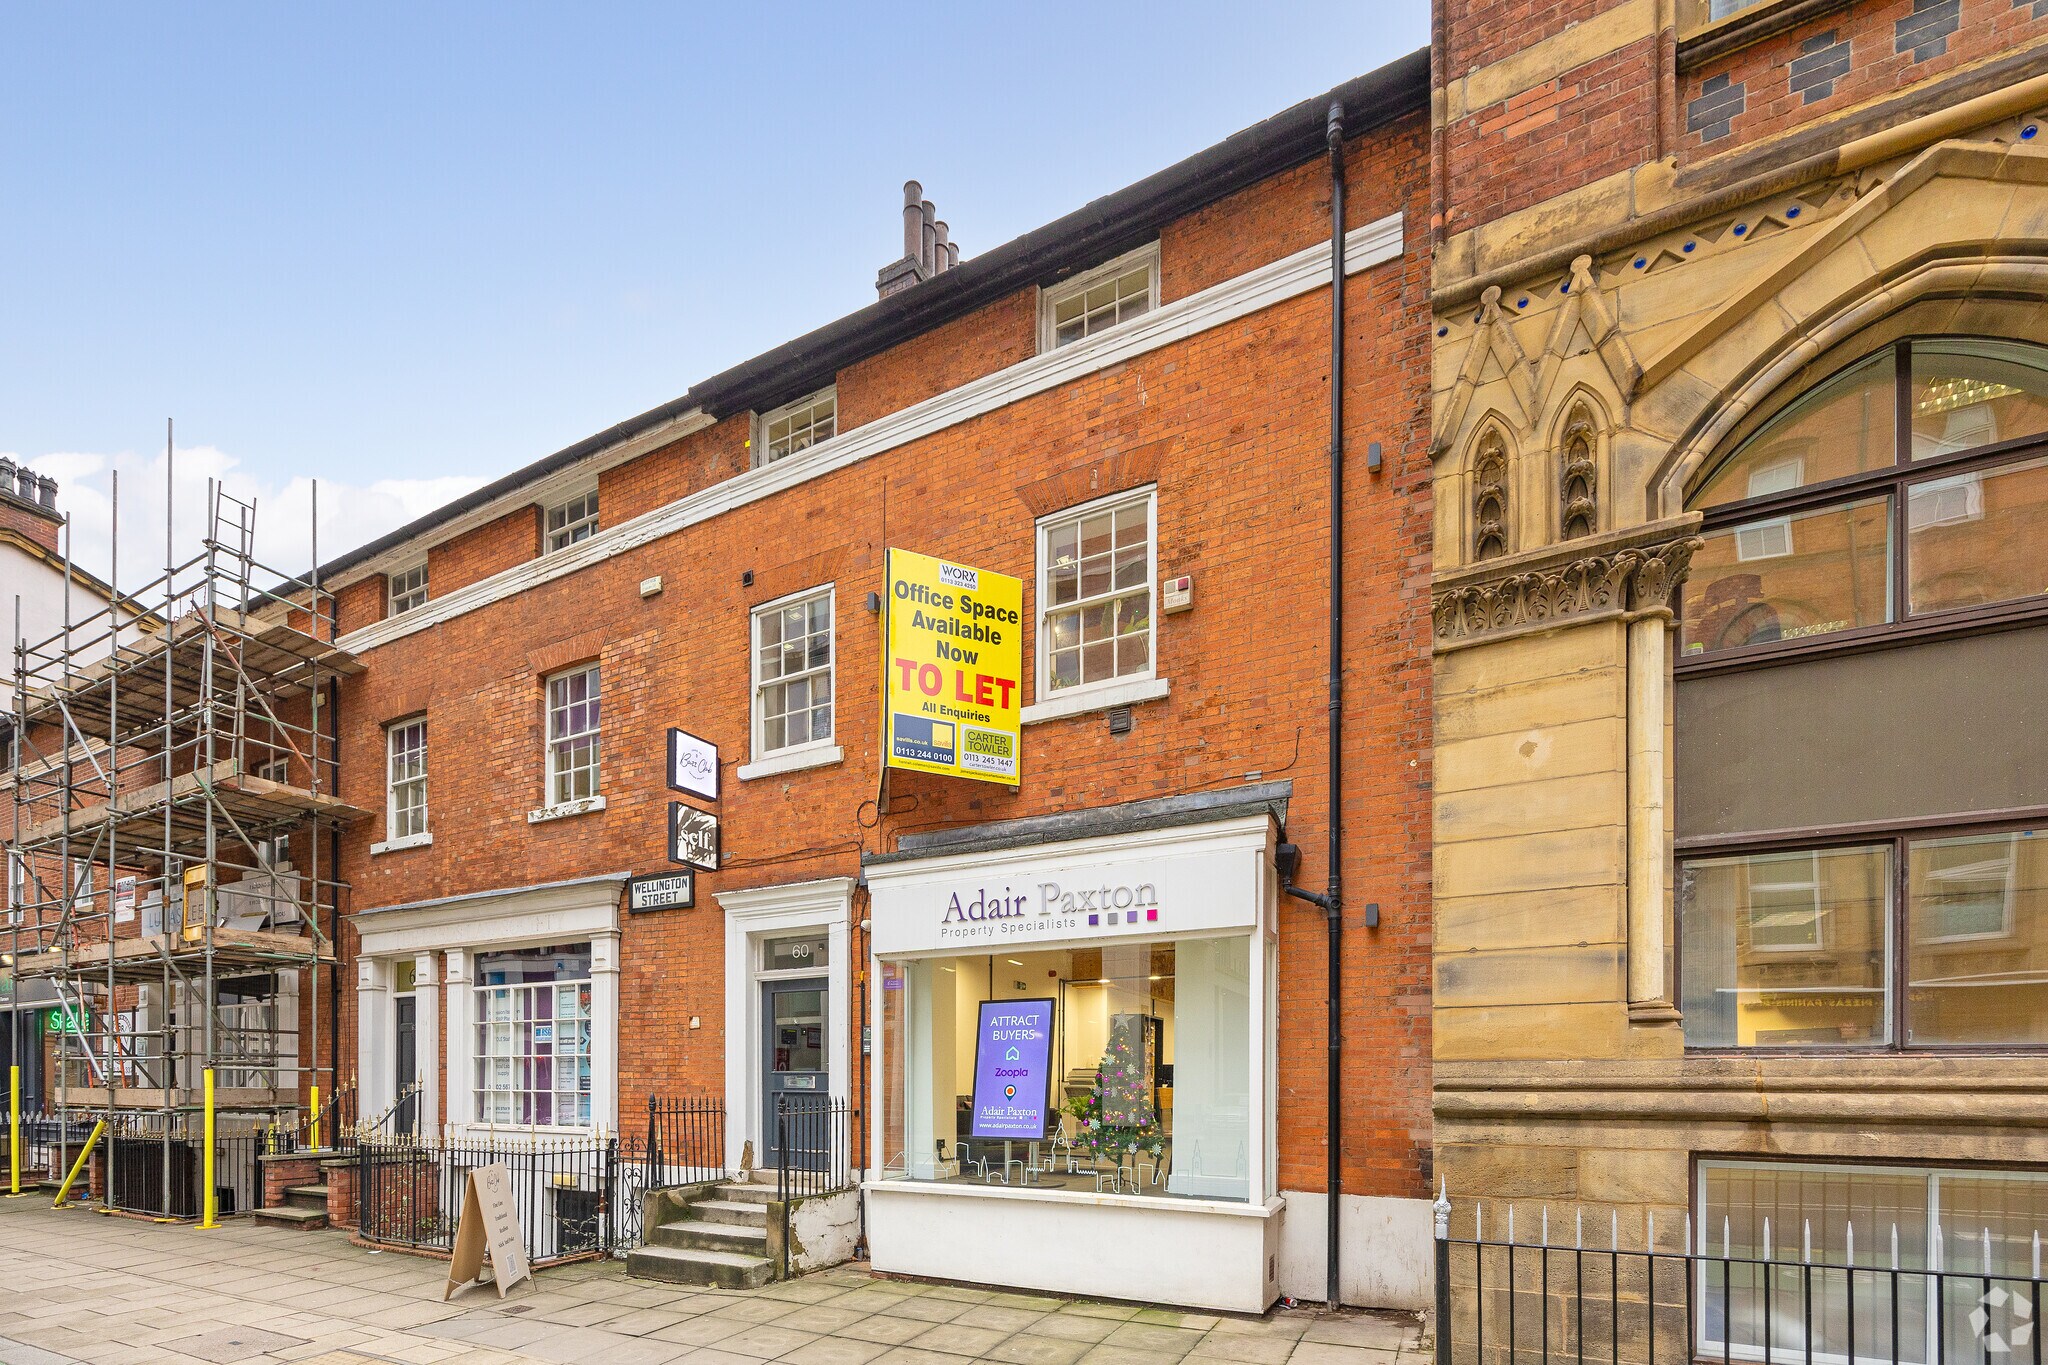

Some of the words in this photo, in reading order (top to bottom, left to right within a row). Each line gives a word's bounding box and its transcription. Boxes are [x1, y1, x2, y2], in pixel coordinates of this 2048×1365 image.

[942, 565, 976, 583] WORX
[895, 580, 953, 609] Office
[960, 595, 1018, 624] Space
[912, 610, 1001, 645] Available
[937, 640, 978, 665] Now
[896, 658, 942, 696] TO
[956, 670, 1015, 709] LET
[922, 702, 936, 713] All
[940, 705, 990, 722] Enquiries
[896, 736, 928, 746] savills.co.uk
[933, 740, 951, 748] savills
[968, 732, 1007, 746] CARTER
[896, 747, 915, 756] 0113
[917, 749, 932, 759] 244
[934, 752, 952, 762] 0100
[969, 741, 1010, 756] TOWLER
[964, 753, 979, 762] 0113
[983, 755, 995, 764] 245
[997, 758, 1013, 767] 1447
[634, 877, 688, 894] WELLINGTON
[641, 891, 679, 906] STREET
[941, 886, 1027, 923] Adair
[1037, 881, 1158, 916] Paxton
[149, 907, 181, 928] LUAS
[941, 922, 995, 938] Property
[1001, 918, 1076, 935] Specialists
[792, 944, 809, 958] 60
[990, 1015, 1040, 1027] ATTRACT
[993, 1029, 1035, 1041] BUYERS
[995, 1067, 1028, 1078] Zoopla
[981, 1106, 1004, 1116] Adair
[1007, 1106, 1037, 1116] Paxton
